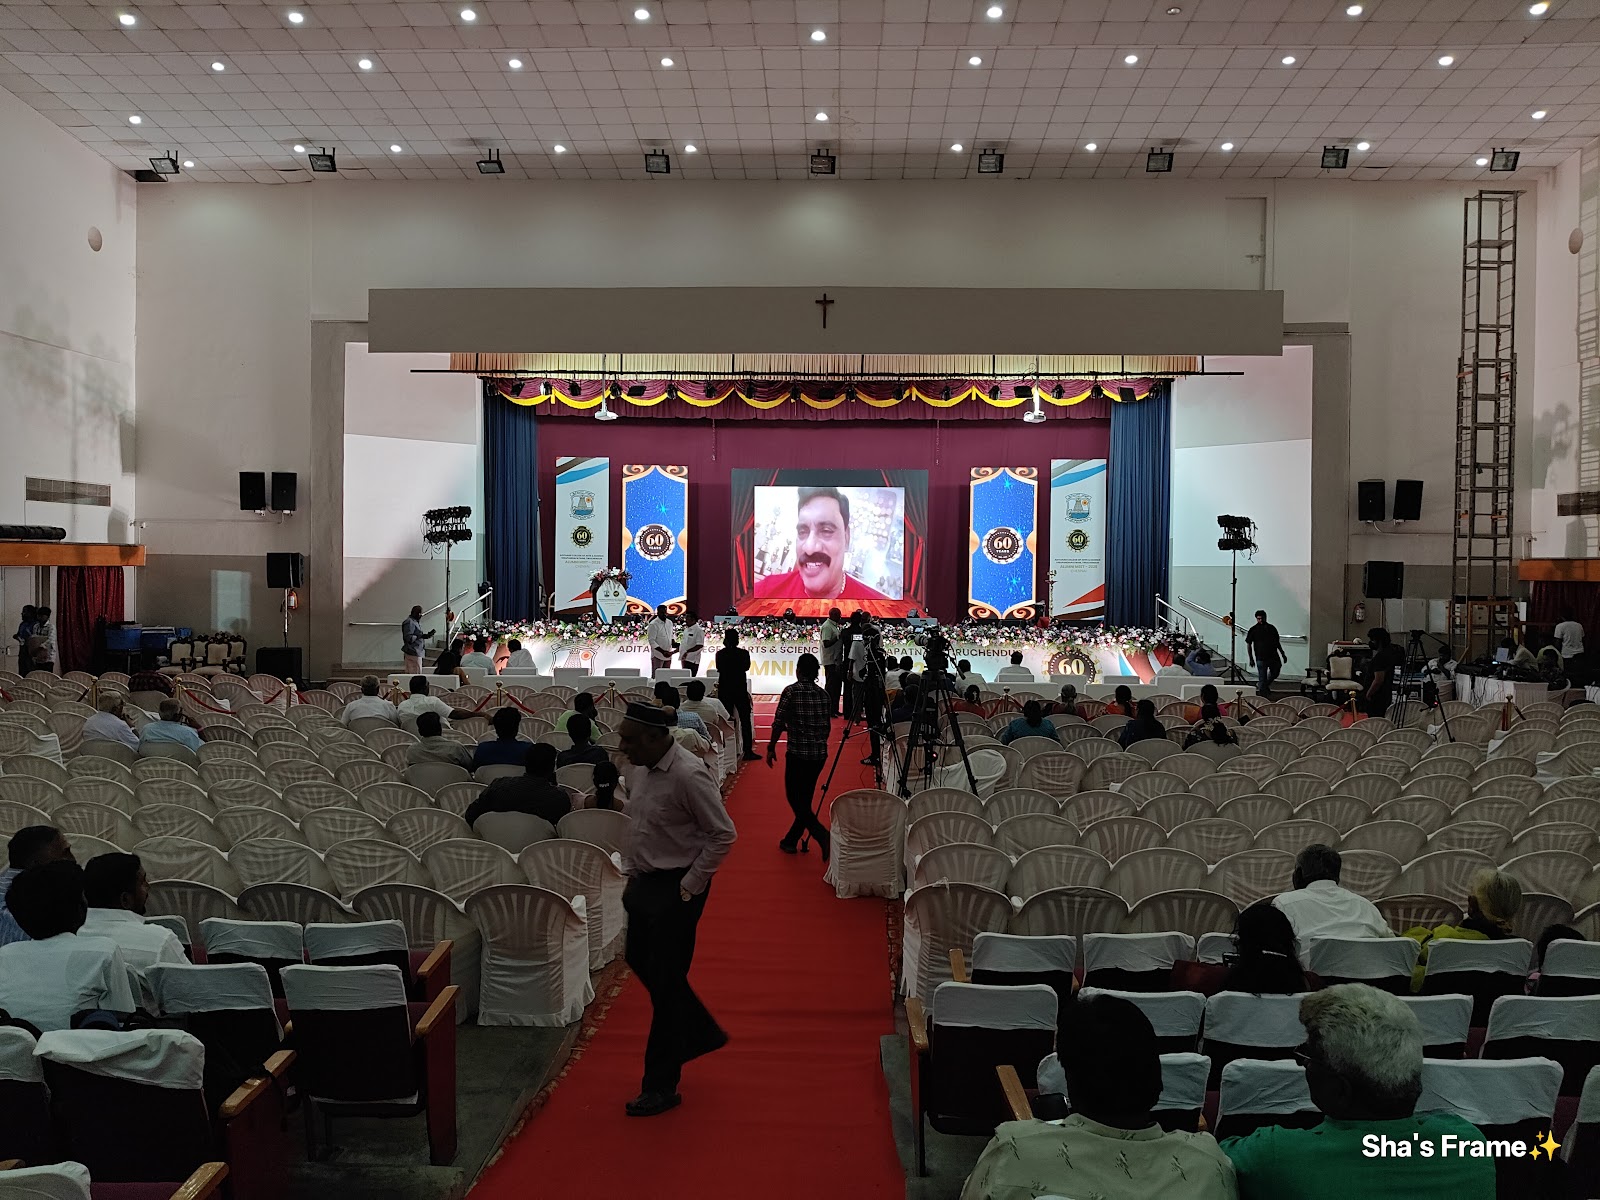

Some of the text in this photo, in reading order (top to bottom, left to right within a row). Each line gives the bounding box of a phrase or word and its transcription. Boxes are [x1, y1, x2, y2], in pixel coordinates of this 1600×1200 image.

[577, 531, 588, 540] 60
[646, 534, 664, 546] 60
[1072, 534, 1084, 543] 60
[993, 537, 1011, 550] 60
[780, 646, 819, 654] SCIENC
[1058, 658, 1085, 676] 60
